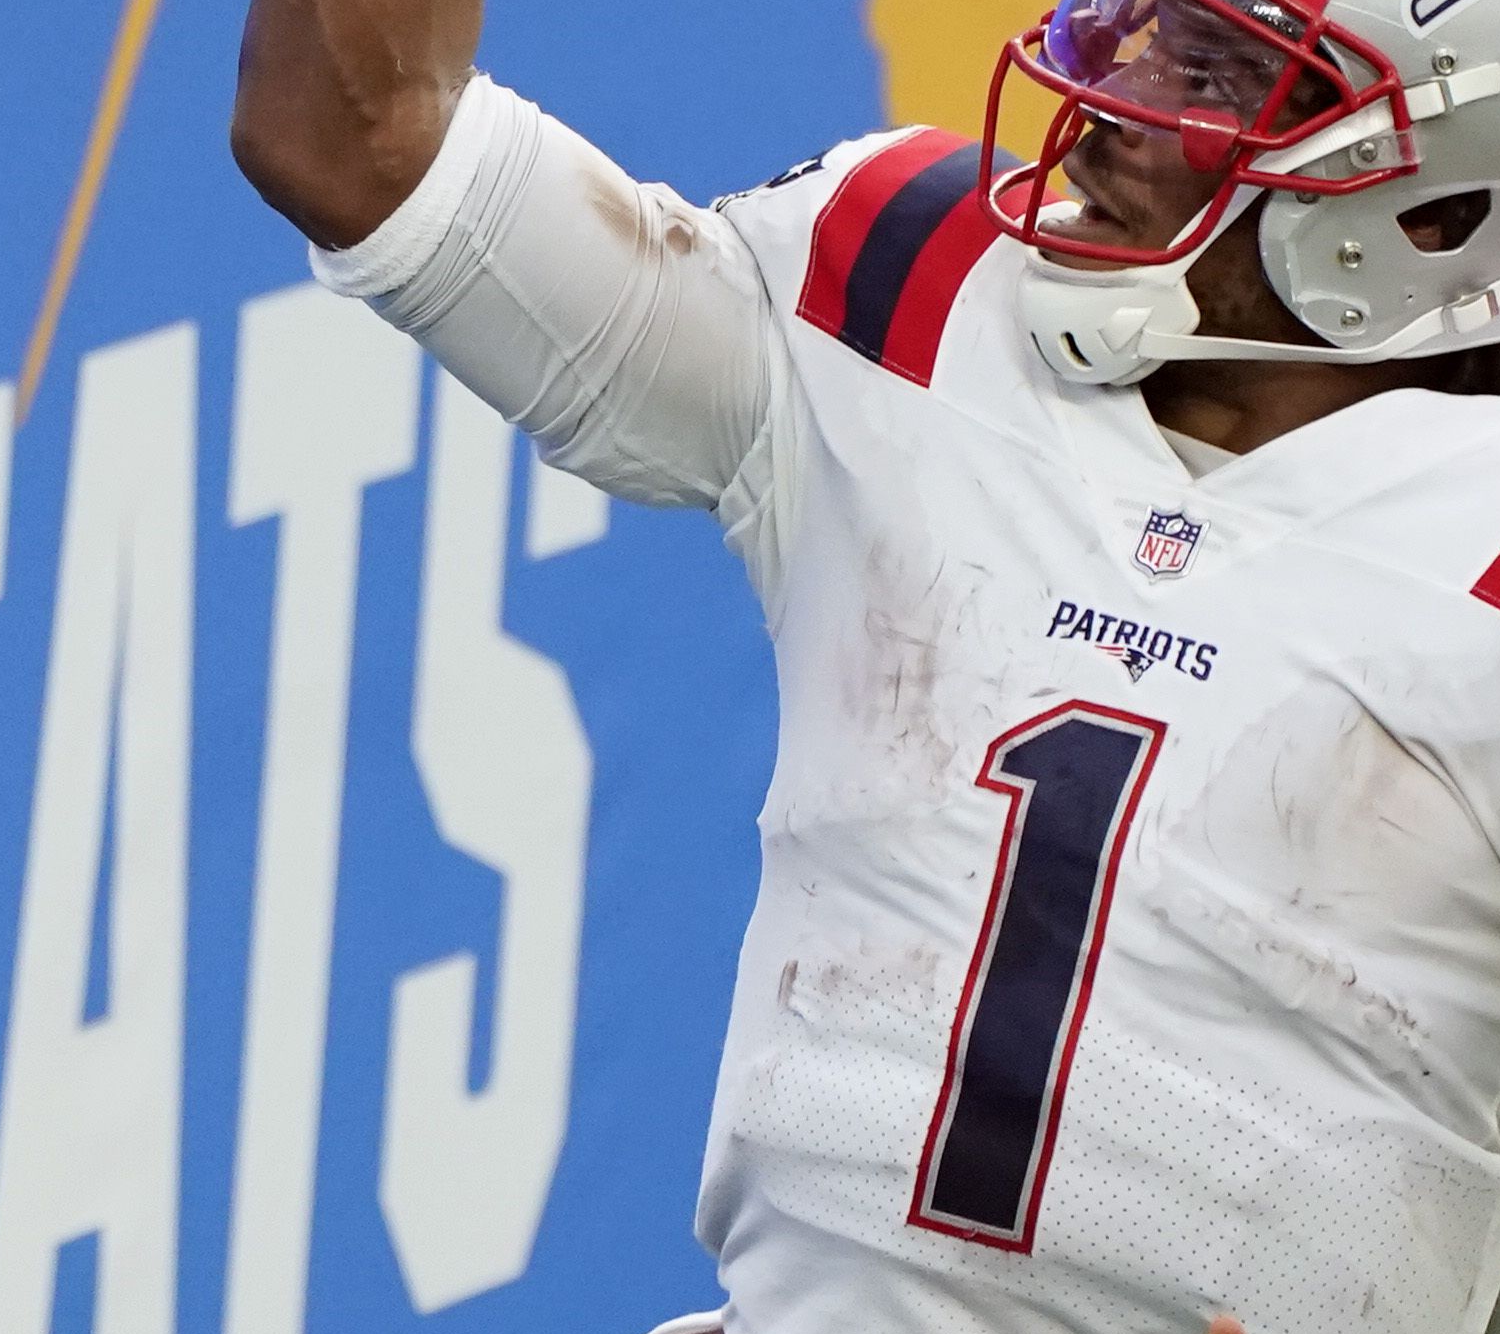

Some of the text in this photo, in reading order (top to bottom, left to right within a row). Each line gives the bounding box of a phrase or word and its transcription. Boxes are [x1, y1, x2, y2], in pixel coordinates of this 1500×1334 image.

[1140, 534, 1185, 568] NFL
[1046, 599, 1219, 681] PATRIOTS
[911, 702, 1166, 1249] 1
